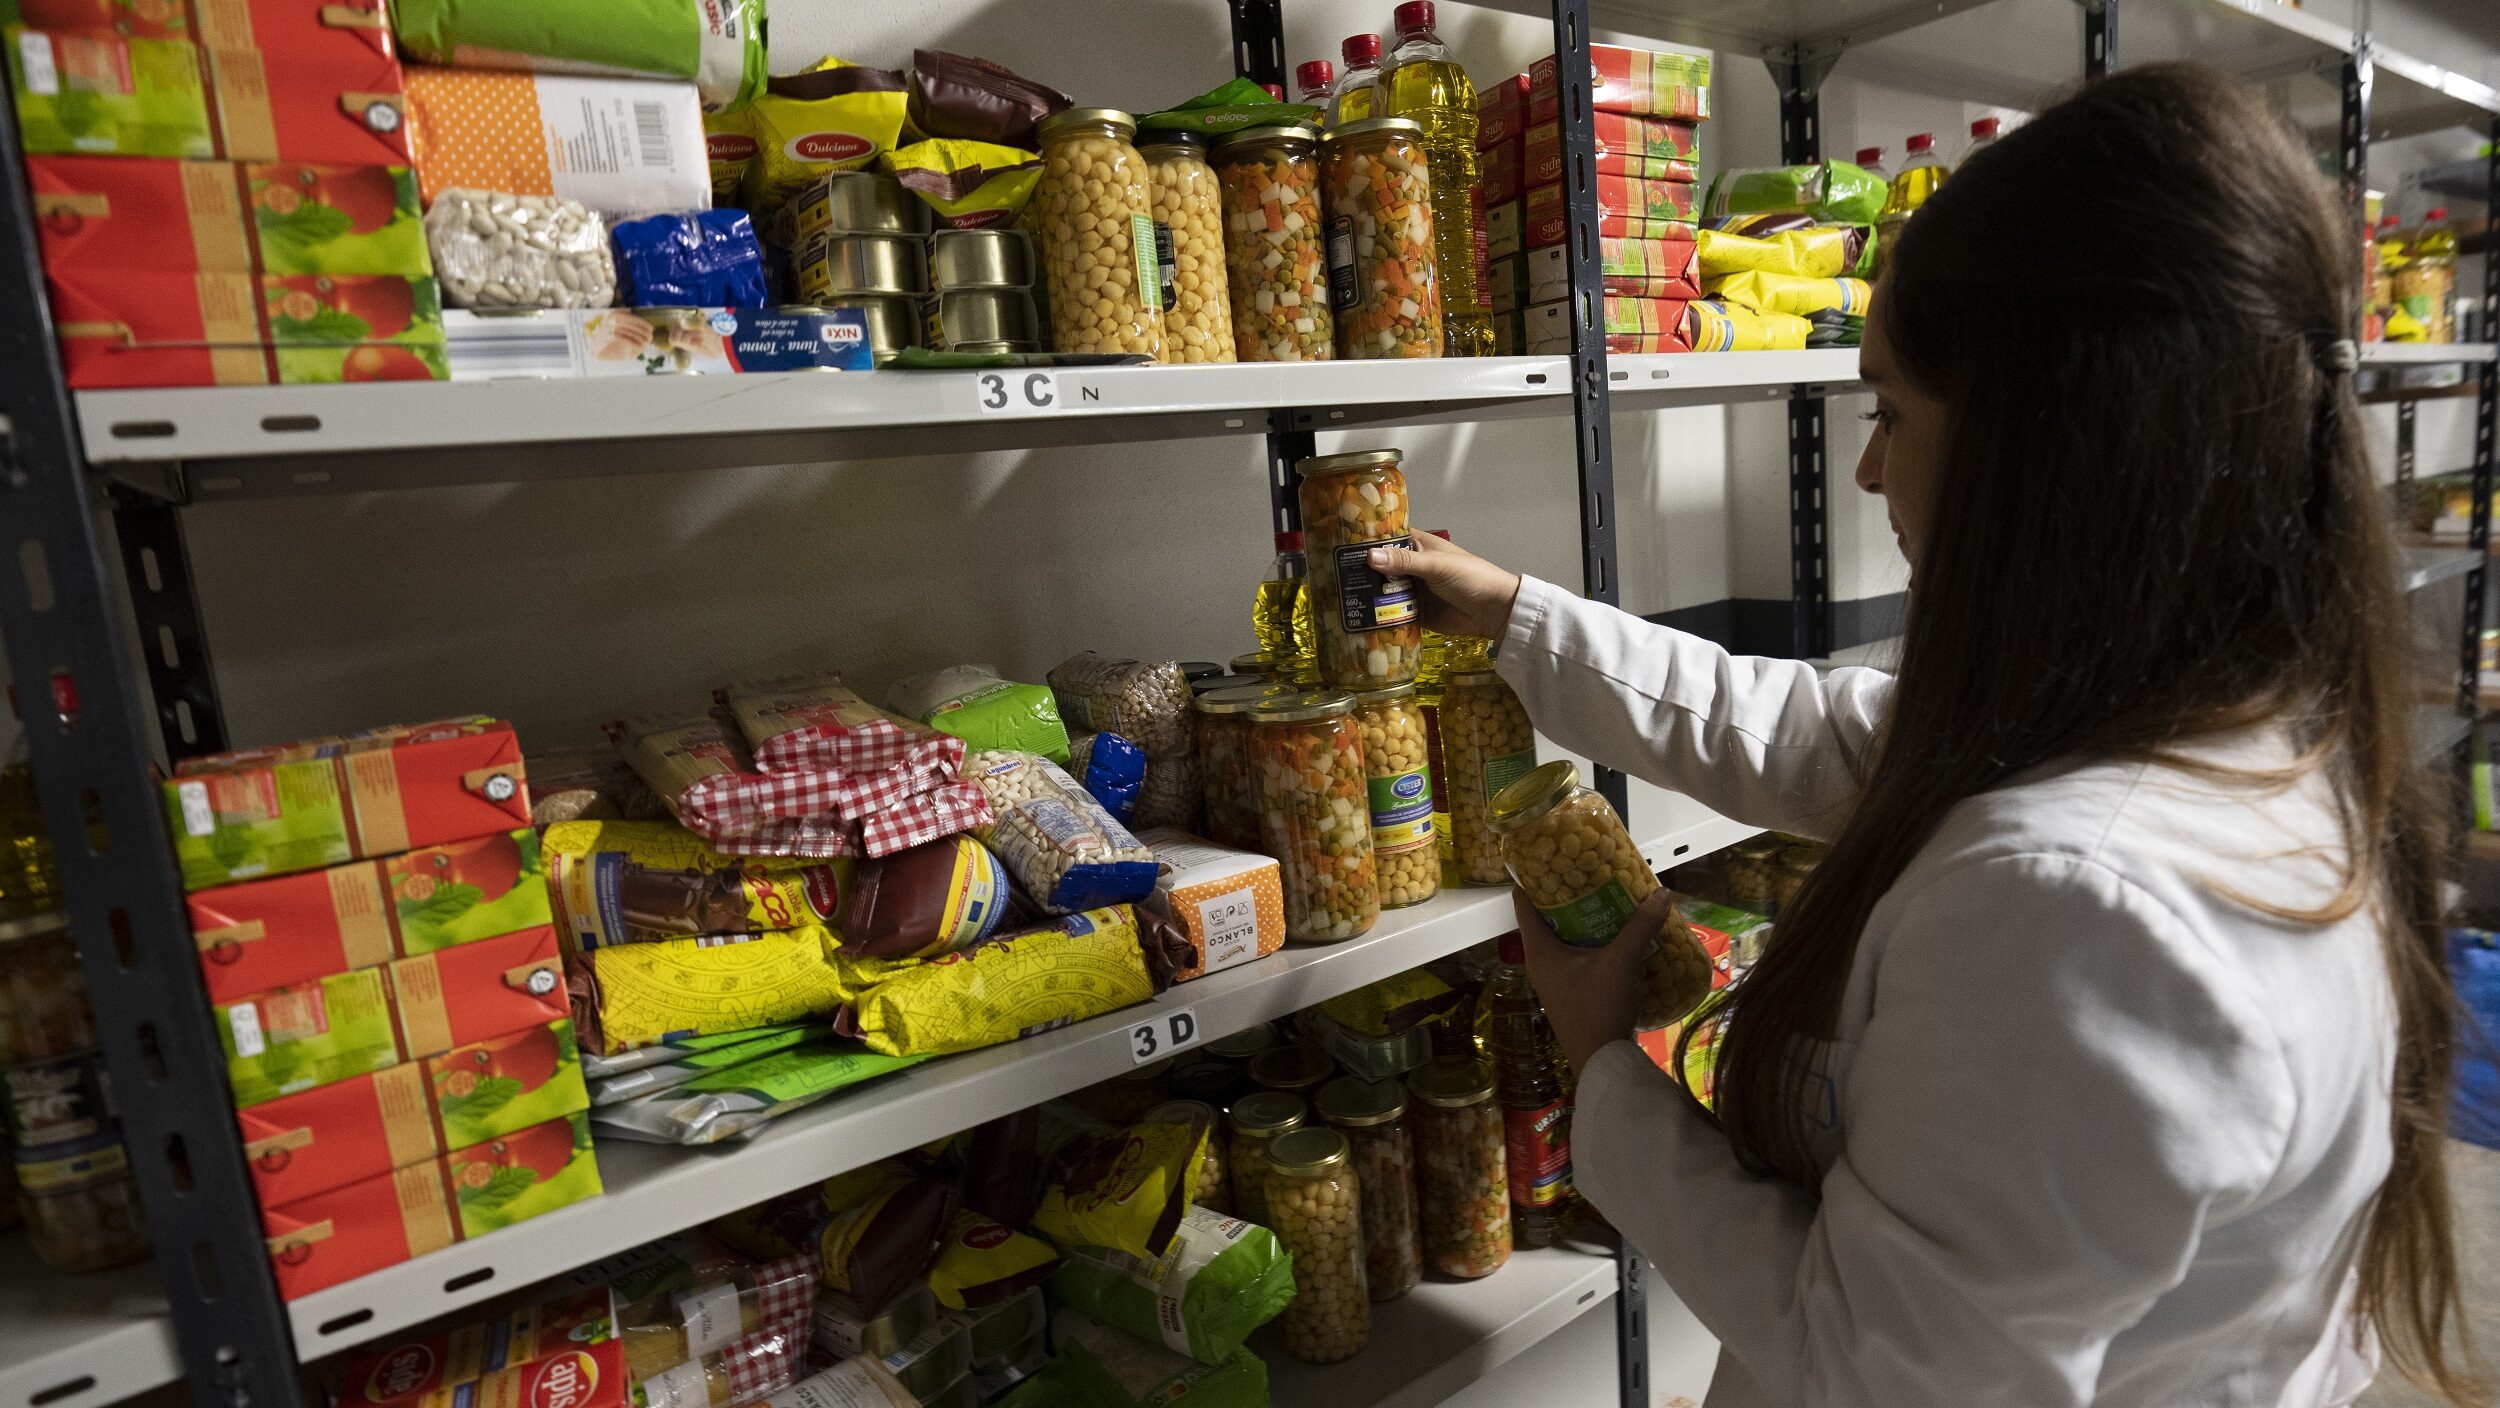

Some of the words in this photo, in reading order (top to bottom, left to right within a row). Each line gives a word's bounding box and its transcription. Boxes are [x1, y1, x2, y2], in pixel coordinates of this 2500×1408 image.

[1533, 66, 1553, 83] apis
[1216, 111, 1249, 123] eliges
[806, 141, 858, 154] Dulcinea
[1540, 158, 1561, 175] apis
[1542, 219, 1563, 237] apis
[738, 340, 779, 356] Tonno
[787, 340, 820, 354] Tuna
[981, 374, 1008, 409] 3
[1023, 373, 1053, 407] C
[1345, 598, 1359, 607] 660
[1347, 610, 1360, 618] 400
[986, 760, 1021, 775] Legumbres
[1398, 779, 1422, 792] CISTER
[1209, 926, 1253, 947] BLANCO
[1134, 1026, 1157, 1057] 3
[1169, 1013, 1194, 1045] D
[383, 1350, 424, 1395] apis
